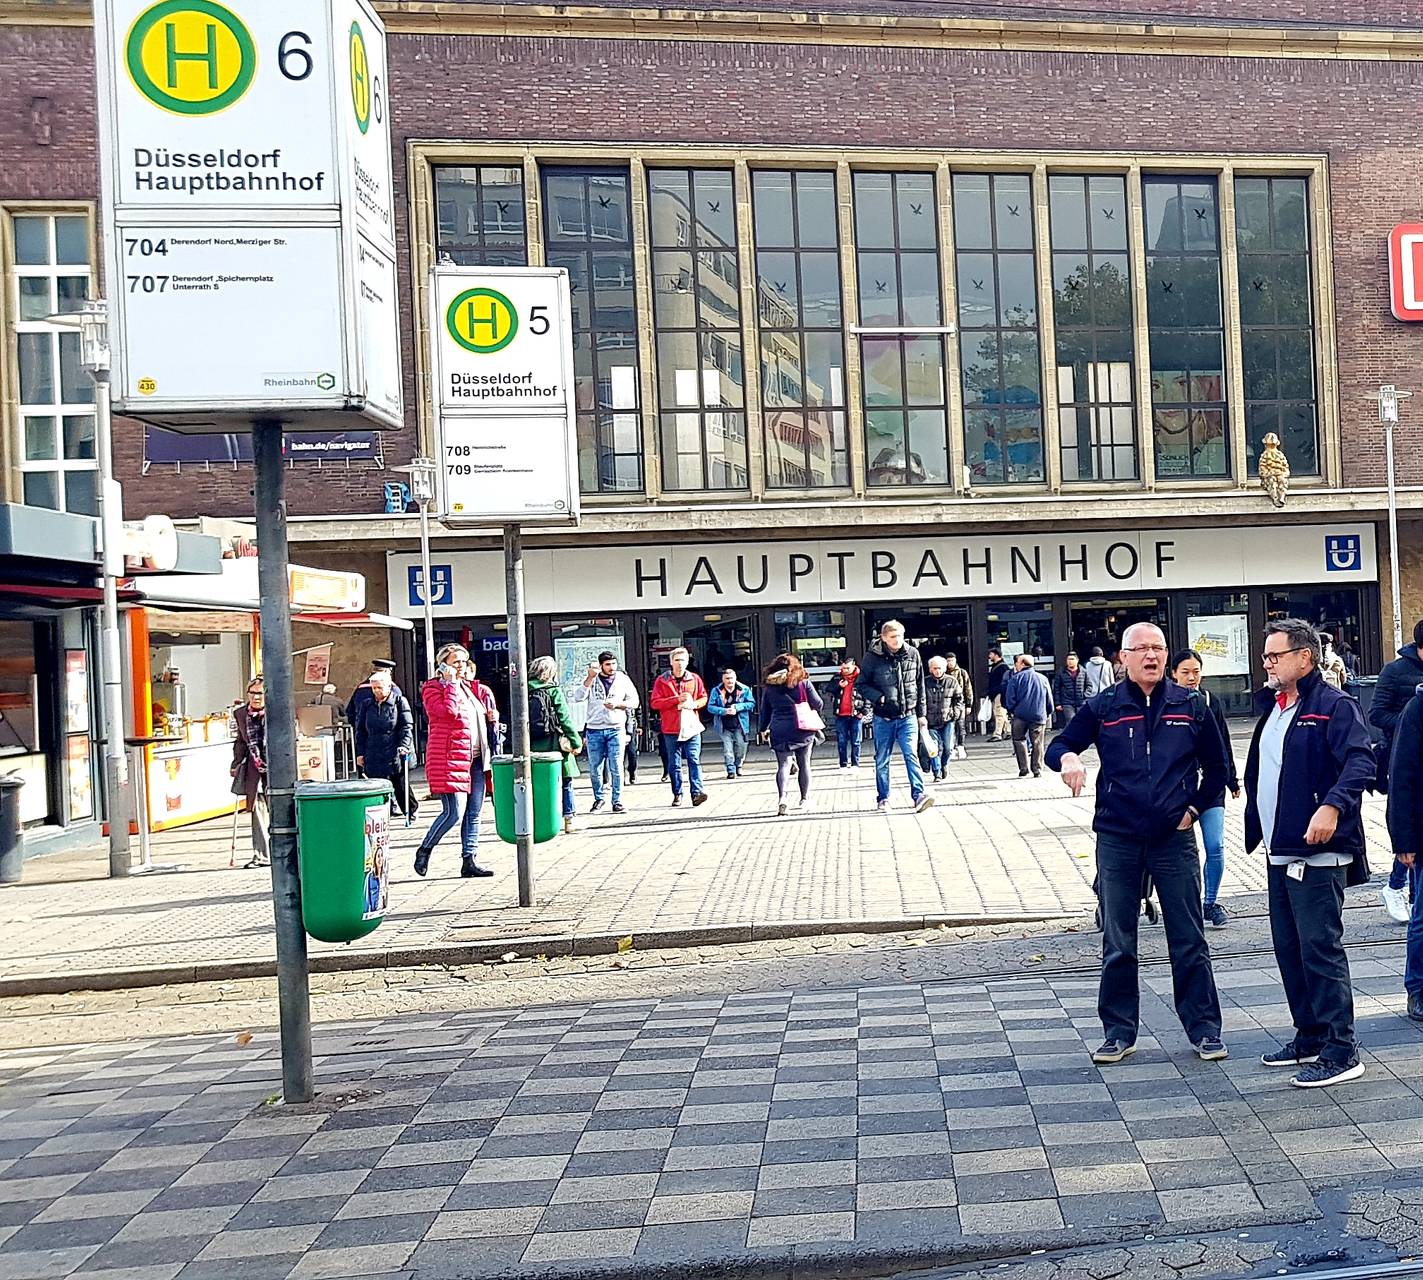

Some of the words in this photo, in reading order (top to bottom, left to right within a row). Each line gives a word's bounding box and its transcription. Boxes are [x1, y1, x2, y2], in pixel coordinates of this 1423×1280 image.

[165, 23, 218, 90] H
[278, 31, 314, 80] 6
[373, 76, 382, 124] 6
[134, 148, 281, 168] Düsseldorf
[135, 172, 325, 194] Hauptbahnhof
[125, 239, 169, 257] 704
[170, 238, 212, 246] Derendorf
[273, 238, 288, 246] Str.
[126, 275, 170, 293] 707
[172, 283, 212, 291] Unterrath
[467, 302, 498, 339] H
[528, 306, 550, 335] 5
[264, 378, 317, 388] Rheinbahn
[451, 372, 532, 385] Düsseldorf
[451, 385, 557, 398] Hauptbahnhof
[291, 441, 370, 451] bahn.de/navigator
[446, 446, 471, 457] 708
[447, 465, 472, 475] 709
[634, 540, 1175, 598] HAUPTBAHNHOF
